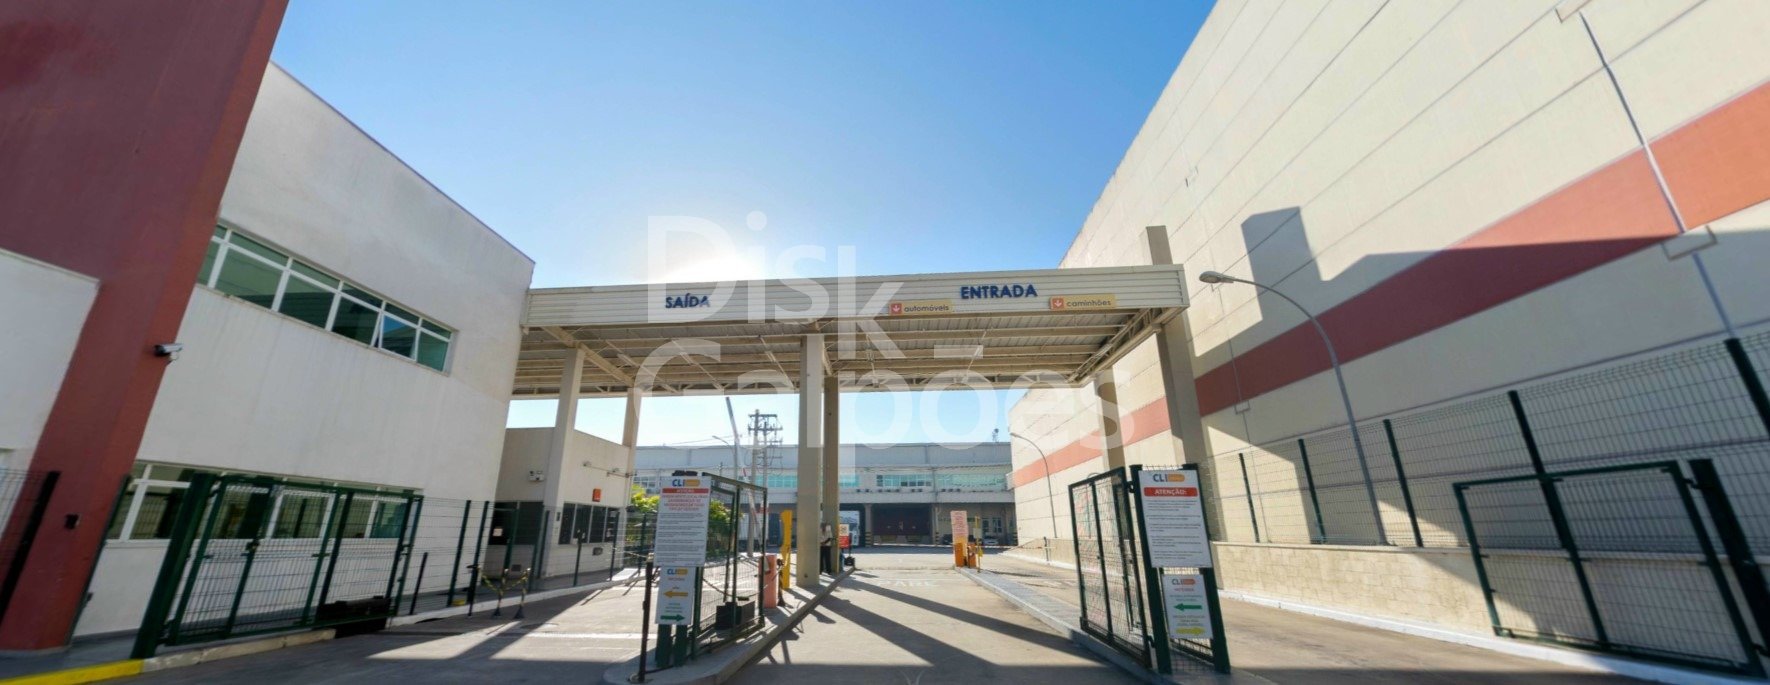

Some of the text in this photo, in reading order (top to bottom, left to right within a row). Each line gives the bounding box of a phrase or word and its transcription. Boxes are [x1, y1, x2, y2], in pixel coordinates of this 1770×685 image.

[960, 284, 1038, 300] ENTRADA
[665, 293, 711, 308] SAÍDA
[1066, 299, 1112, 309] caminhões
[904, 304, 950, 314] automóveis
